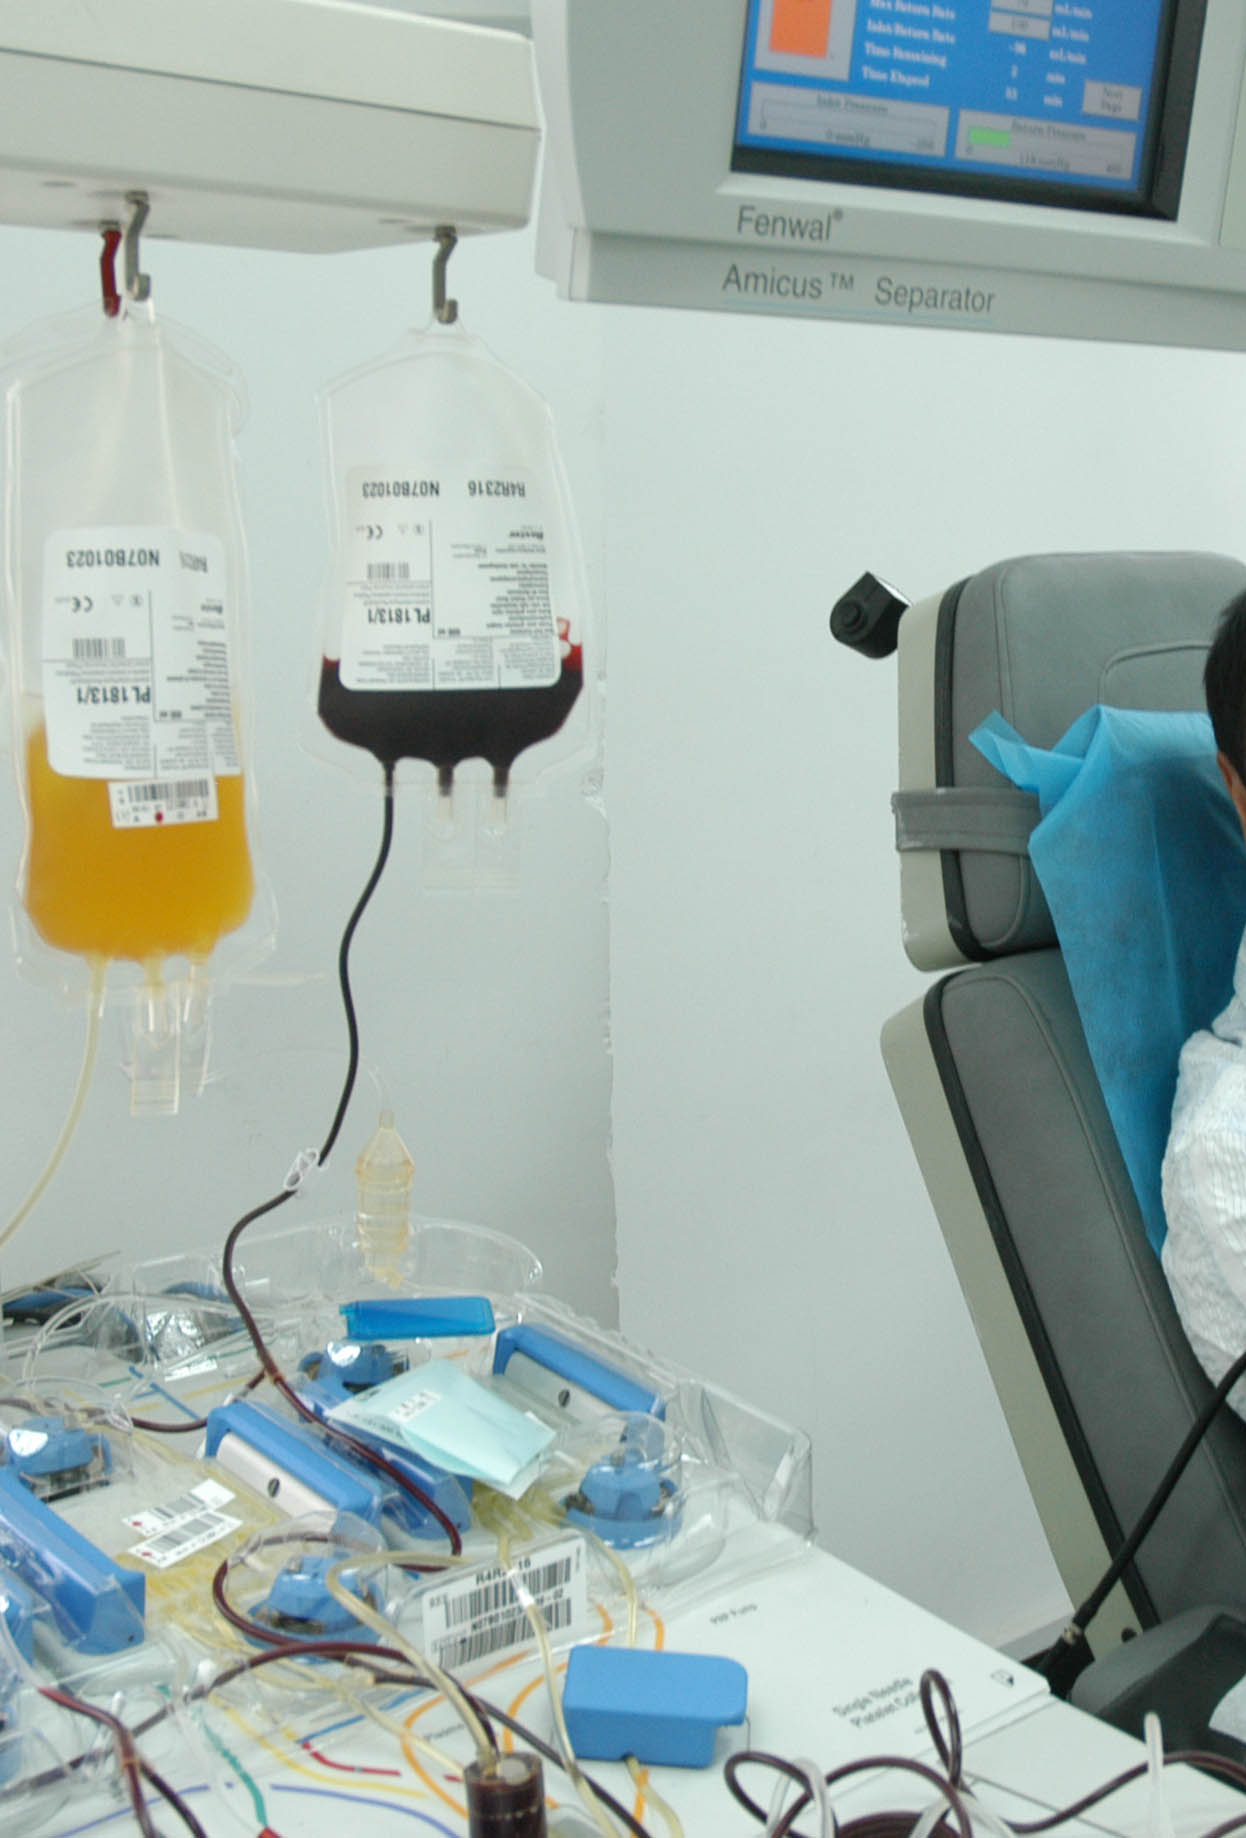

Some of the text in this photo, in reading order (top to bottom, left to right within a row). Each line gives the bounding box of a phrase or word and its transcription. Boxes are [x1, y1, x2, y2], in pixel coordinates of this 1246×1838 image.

[875, 275, 995, 313] Separator
[66, 549, 161, 569] N07B01023
[368, 607, 431, 624] PL 1813/1
[76, 685, 151, 705] PL 1813/1
